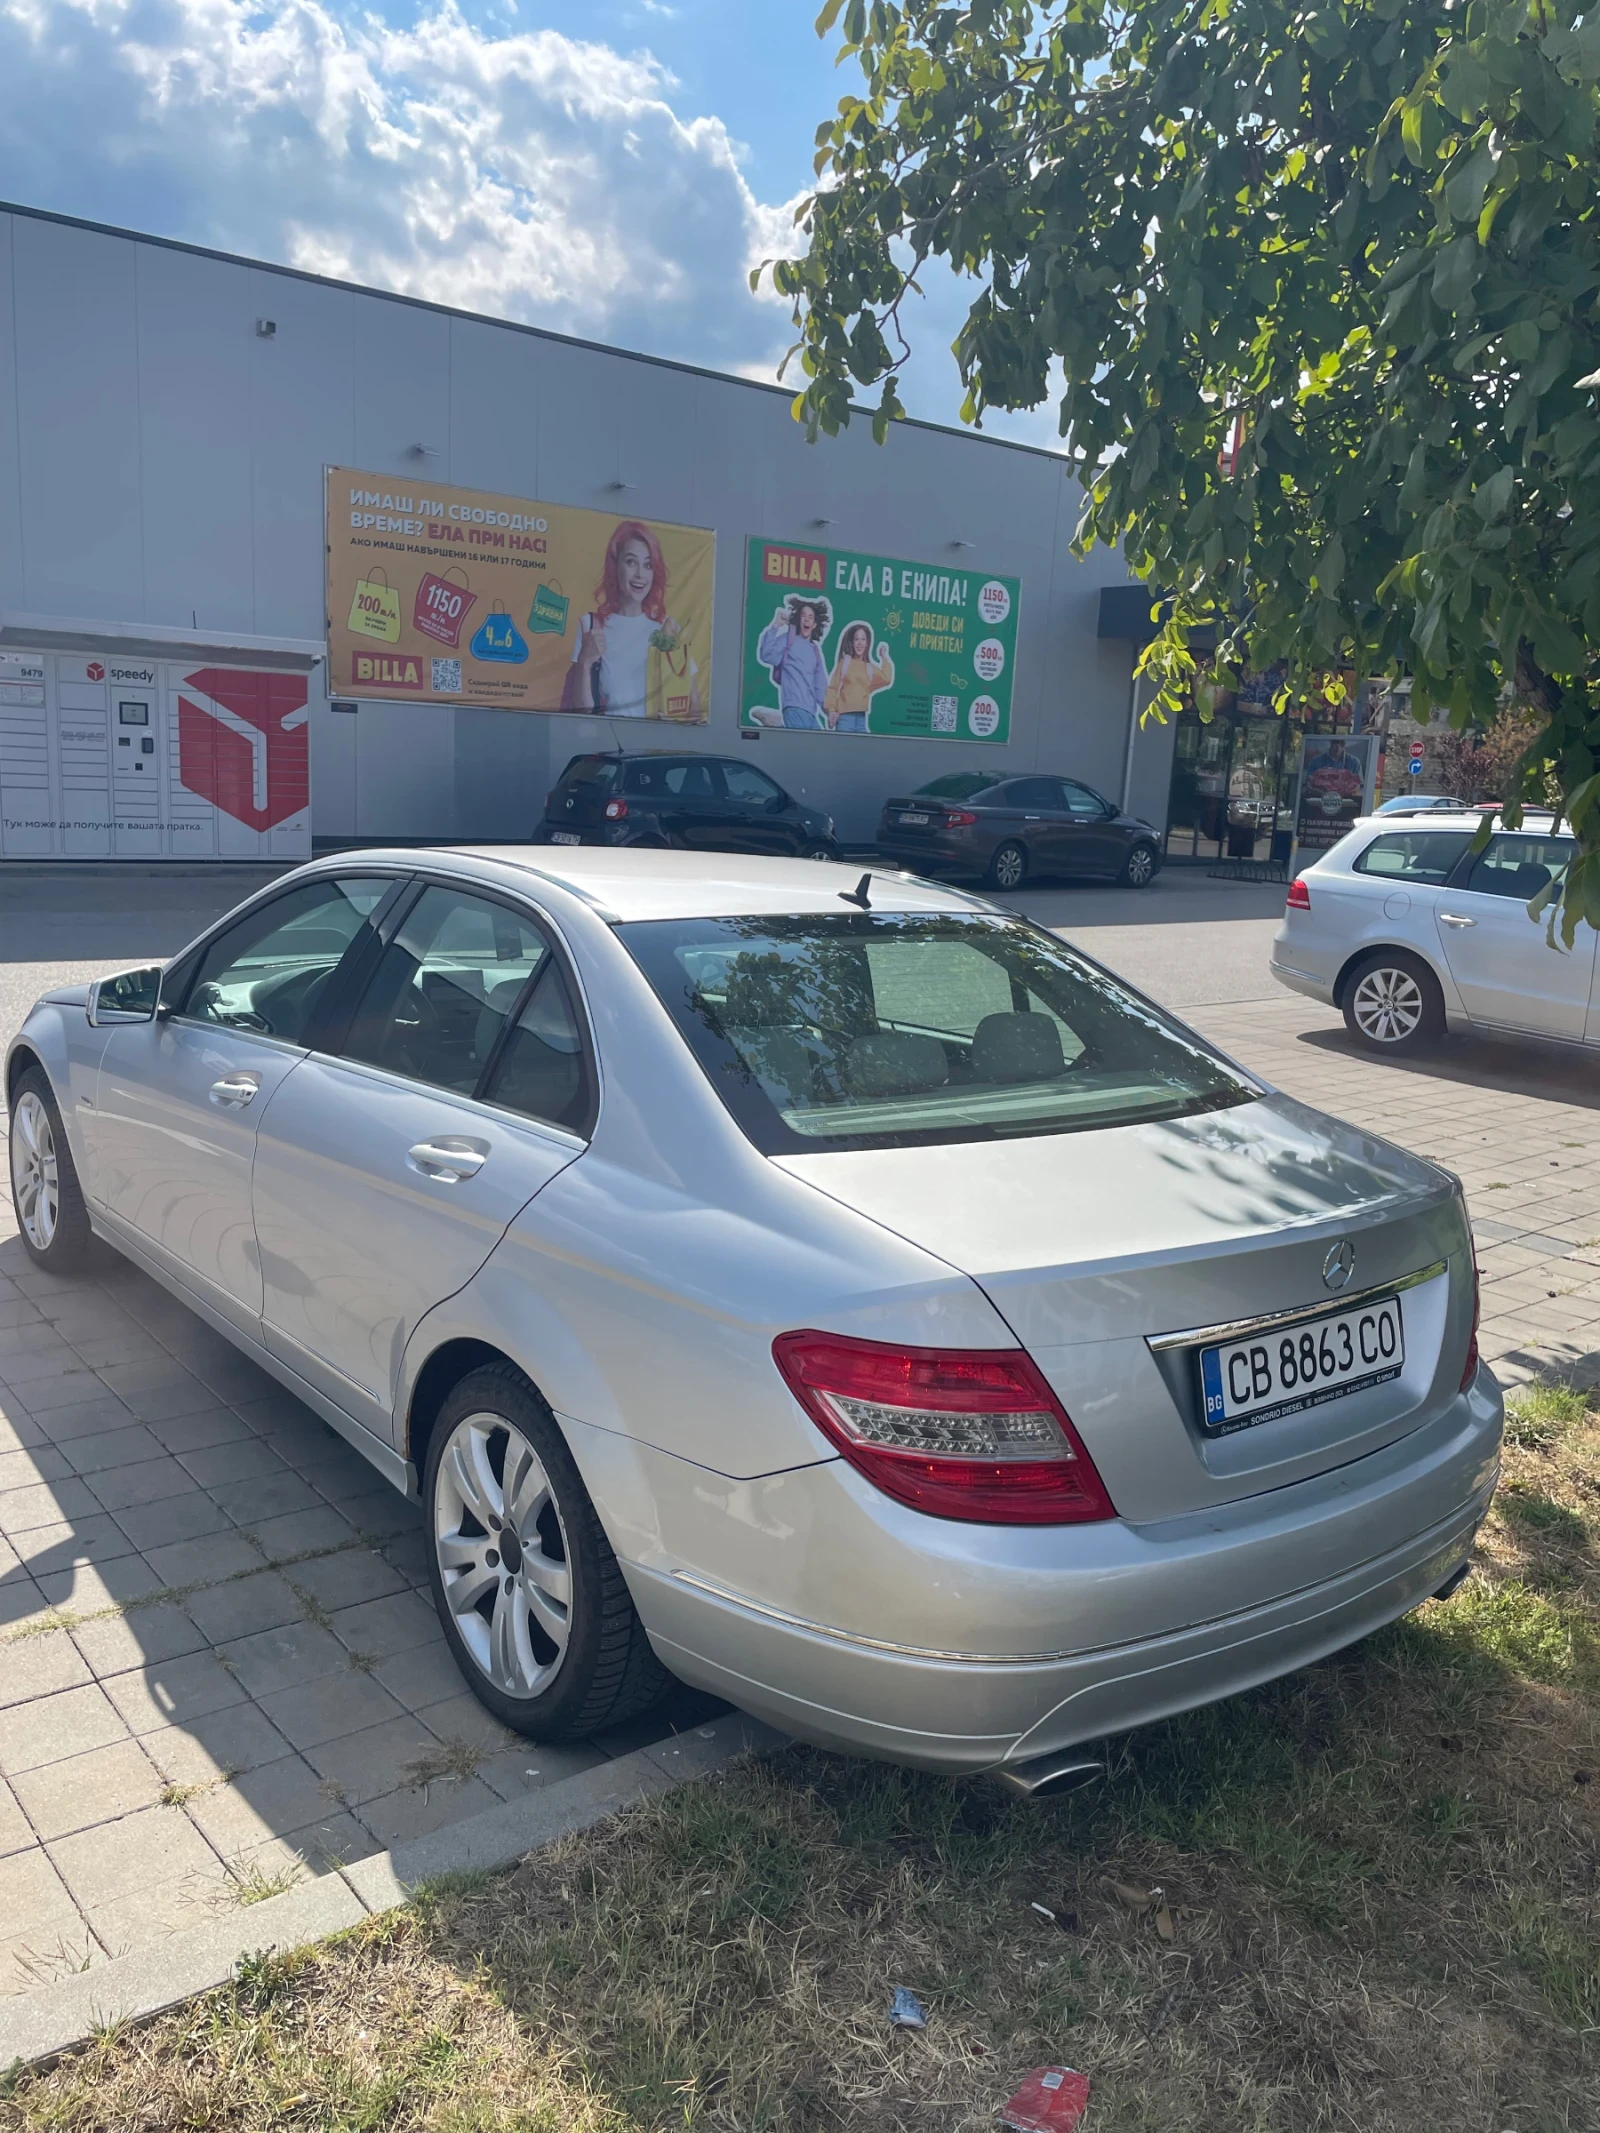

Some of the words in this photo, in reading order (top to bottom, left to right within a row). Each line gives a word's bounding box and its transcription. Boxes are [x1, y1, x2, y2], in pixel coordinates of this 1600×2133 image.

[350, 488, 414, 514] ИМАШ
[417, 500, 444, 518] ЛИ
[448, 504, 548, 533] СВОБОДНО
[350, 511, 424, 537] ВРЕМЕ?
[428, 522, 464, 542] ЕЛА
[469, 528, 505, 548] ПРИ
[509, 534, 547, 554] НАС!
[350, 537, 371, 547] АКО
[373, 540, 405, 552] ИМАШ
[407, 544, 467, 560] НАВЪРШЕНИ
[468, 553, 478, 561] 16
[480, 555, 499, 564] ИЛИ
[500, 557, 509, 565] 17
[511, 558, 546, 570] ГОДИНИ
[767, 552, 822, 583] BILLA
[835, 560, 874, 594] ЕЛА
[881, 566, 894, 597] В
[901, 570, 968, 607] ЕКИПА!
[357, 593, 381, 614] 200
[426, 584, 462, 618] 1150
[983, 587, 1003, 603] 1150
[533, 603, 564, 622] ЗДРАВНА
[912, 611, 949, 632] ДОВЕДИ
[951, 616, 964, 633] СИ
[485, 625, 494, 646] 4
[505, 628, 512, 648] 6
[910, 632, 916, 648] И
[919, 633, 964, 654] ПРИЯТЕЛ!
[980, 646, 998, 660] 500
[20, 668, 43, 678] 9479
[111, 668, 154, 683] speedy
[357, 657, 419, 684] BILLA
[974, 702, 992, 715] 200
[3, 819, 22, 829] Тук
[25, 820, 56, 828] може
[74, 821, 124, 831] получите
[127, 822, 164, 831] вашата
[167, 823, 204, 831] пратка.
[1228, 1346, 1272, 1405] CB
[1280, 1322, 1354, 1389] 8863
[1359, 1310, 1396, 1364] CO
[1208, 1394, 1222, 1413] BG
[1250, 1408, 1281, 1425] SONDRIO
[1281, 1402, 1304, 1416] DIESEL
